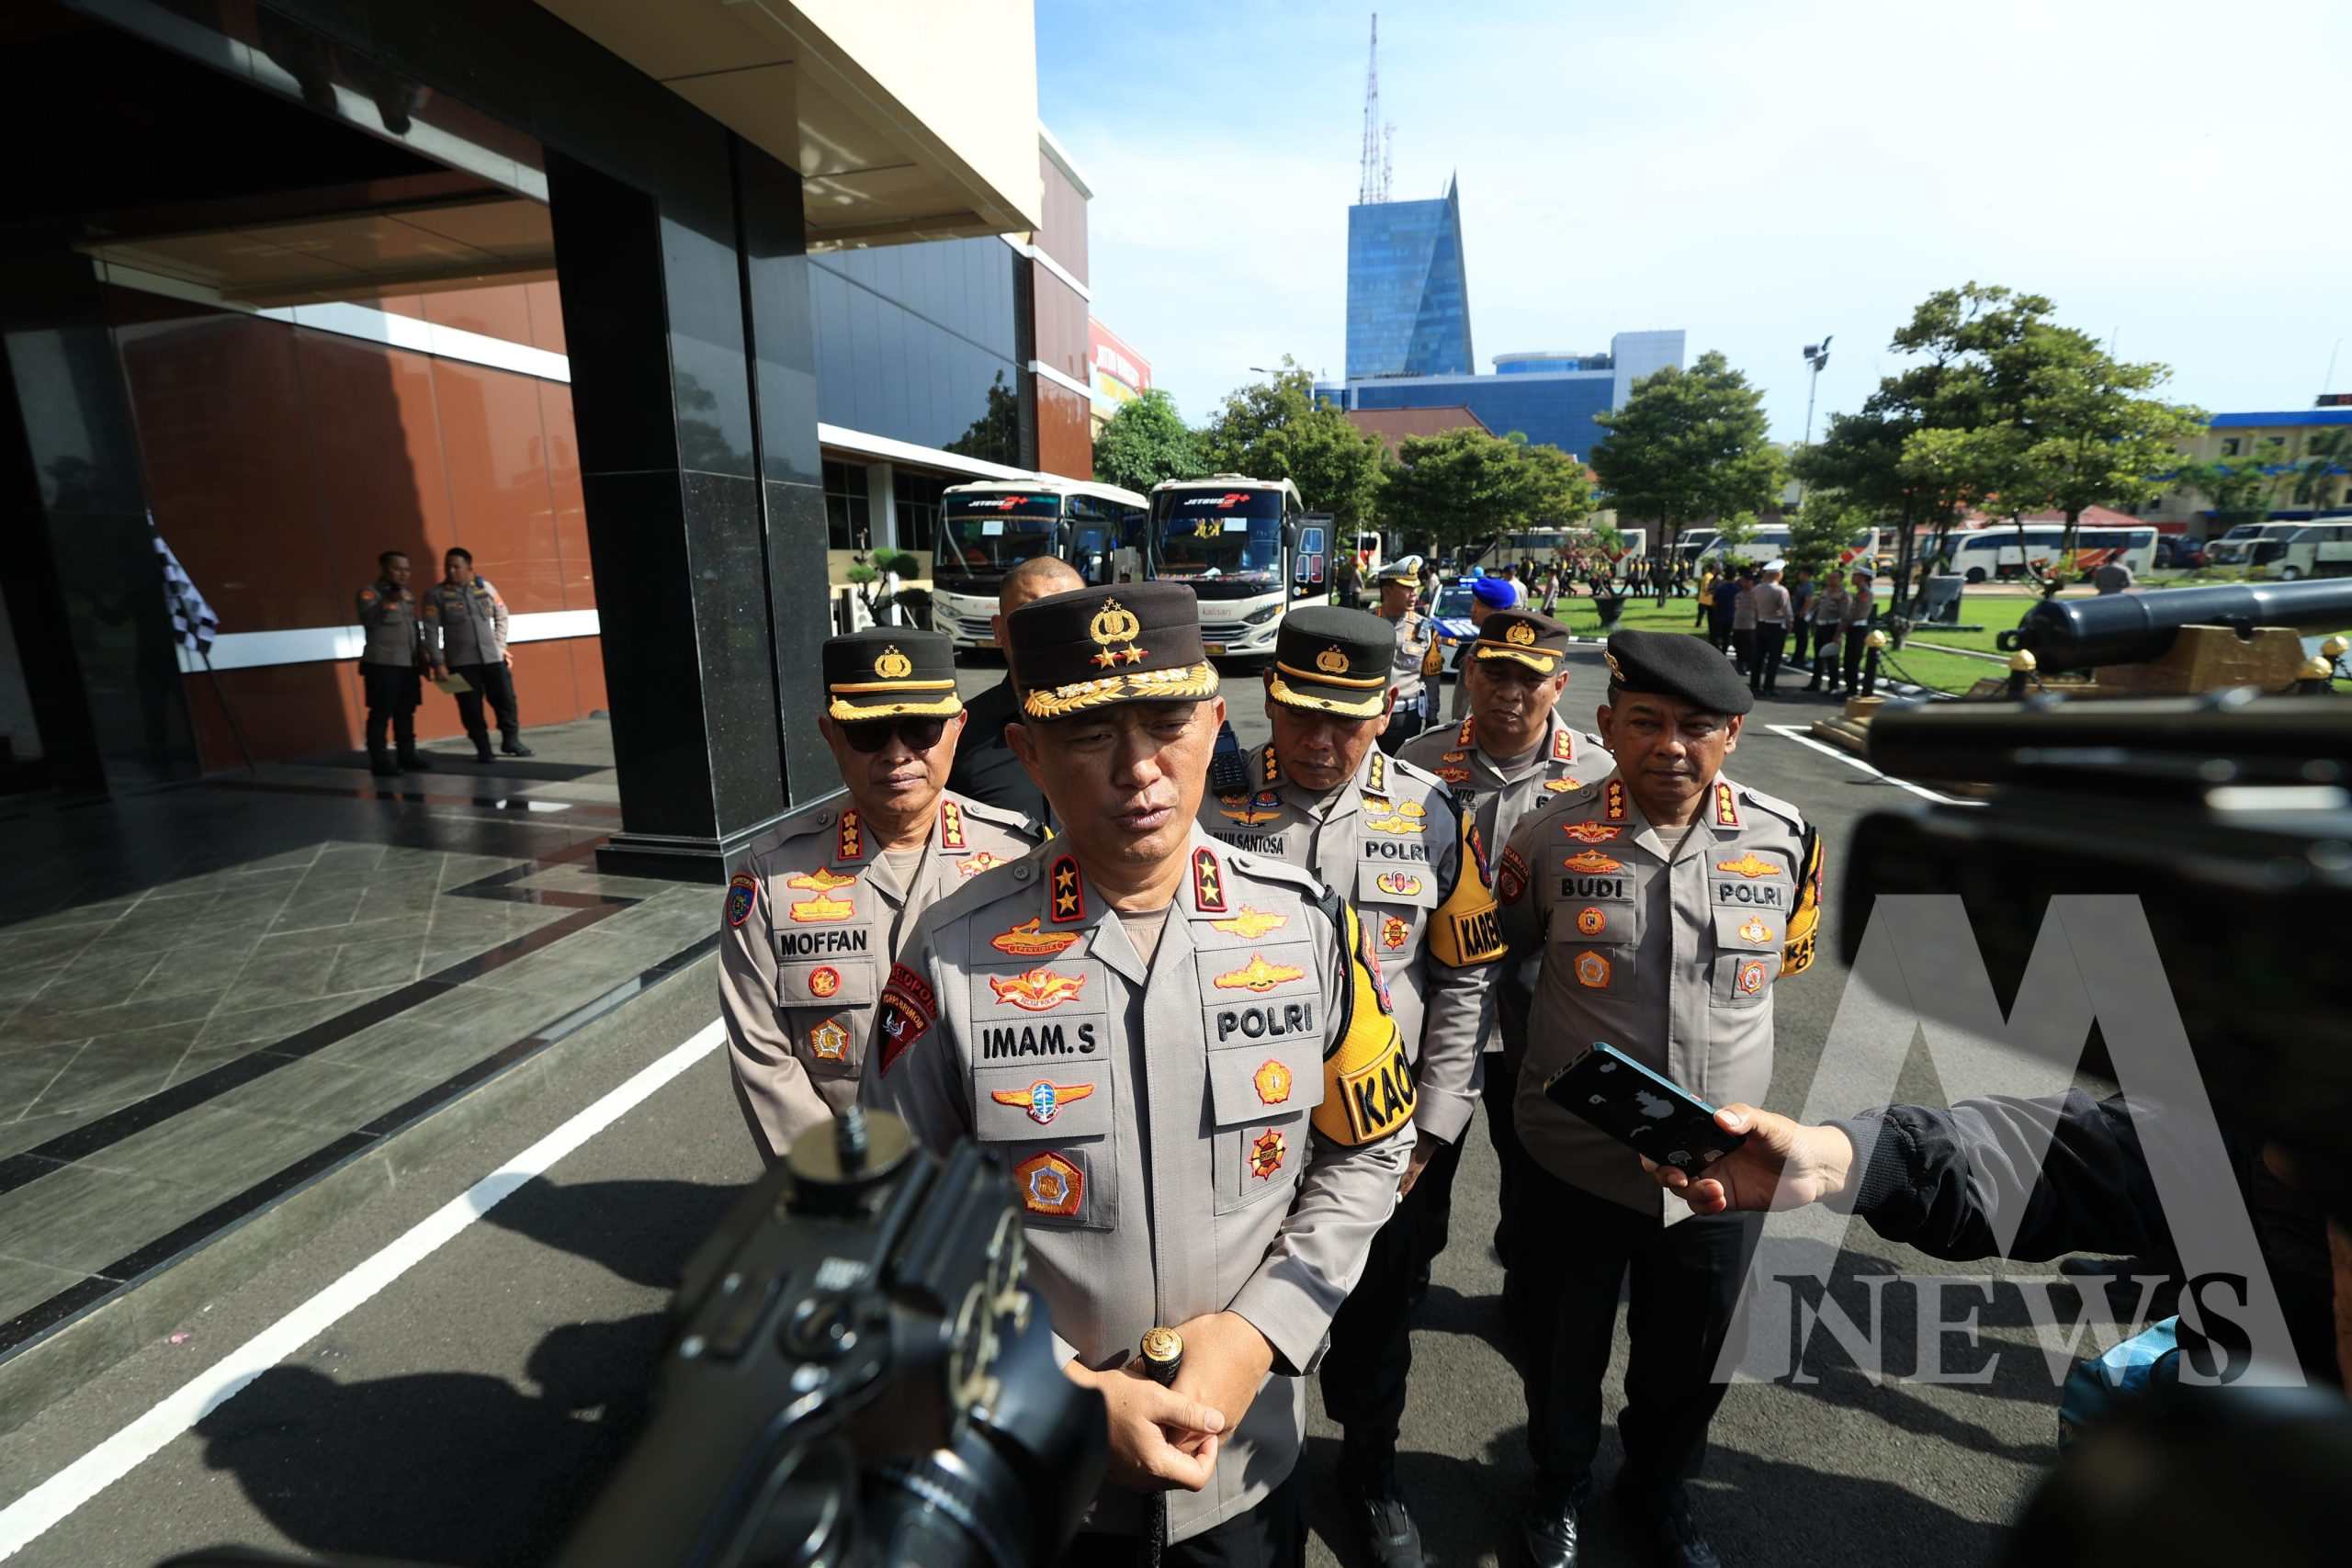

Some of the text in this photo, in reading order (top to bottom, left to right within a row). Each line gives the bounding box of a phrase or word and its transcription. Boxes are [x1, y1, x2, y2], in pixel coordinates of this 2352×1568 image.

[1365, 840, 1430, 862] POLRI
[1562, 877, 1623, 897] BUDI
[1719, 882, 1782, 907] POLRI
[780, 929, 868, 956] MOFFAN
[1216, 1002, 1314, 1043] POLRI
[983, 1023, 1096, 1059] IMAM.S
